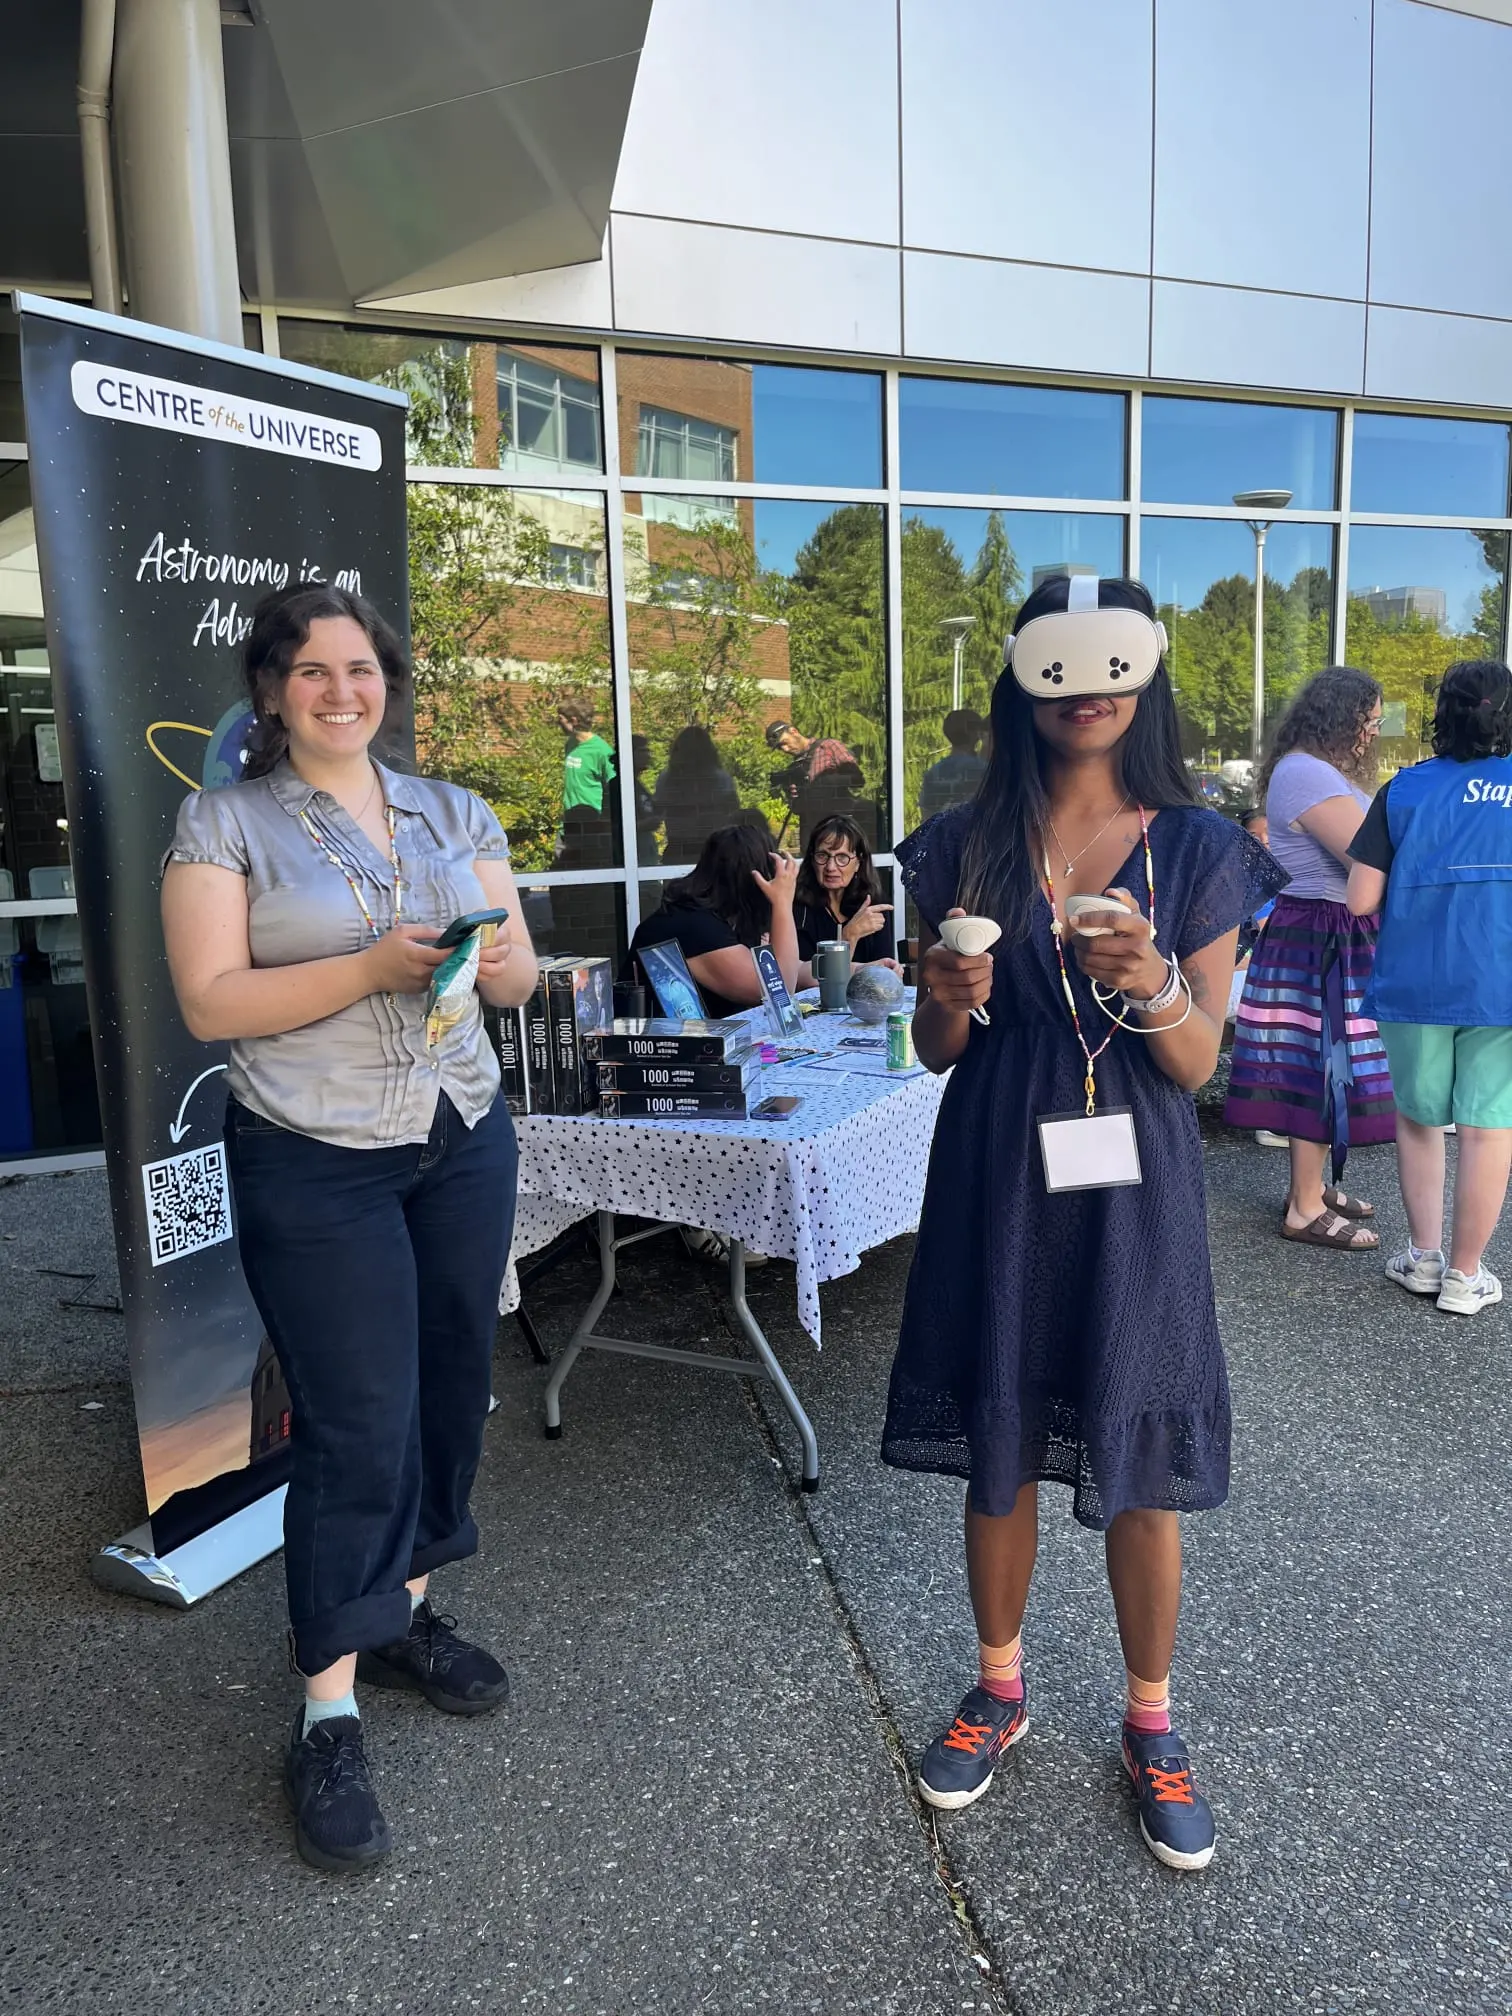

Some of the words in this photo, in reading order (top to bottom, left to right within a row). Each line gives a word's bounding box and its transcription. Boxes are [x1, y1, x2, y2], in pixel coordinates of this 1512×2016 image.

[96, 378, 205, 426] CENTRE
[208, 405, 224, 428] of
[225, 413, 245, 433] the
[249, 412, 361, 460] UNIVERSE
[136, 531, 289, 591] Astronomy
[334, 568, 362, 597] an
[193, 597, 256, 647] Adv
[531, 1017, 546, 1044] 1000
[558, 1017, 573, 1044] 1000
[501, 1043, 516, 1070] 1000
[627, 1040, 654, 1054] 1000
[642, 1069, 669, 1083] 1000
[646, 1098, 673, 1112] 1000
